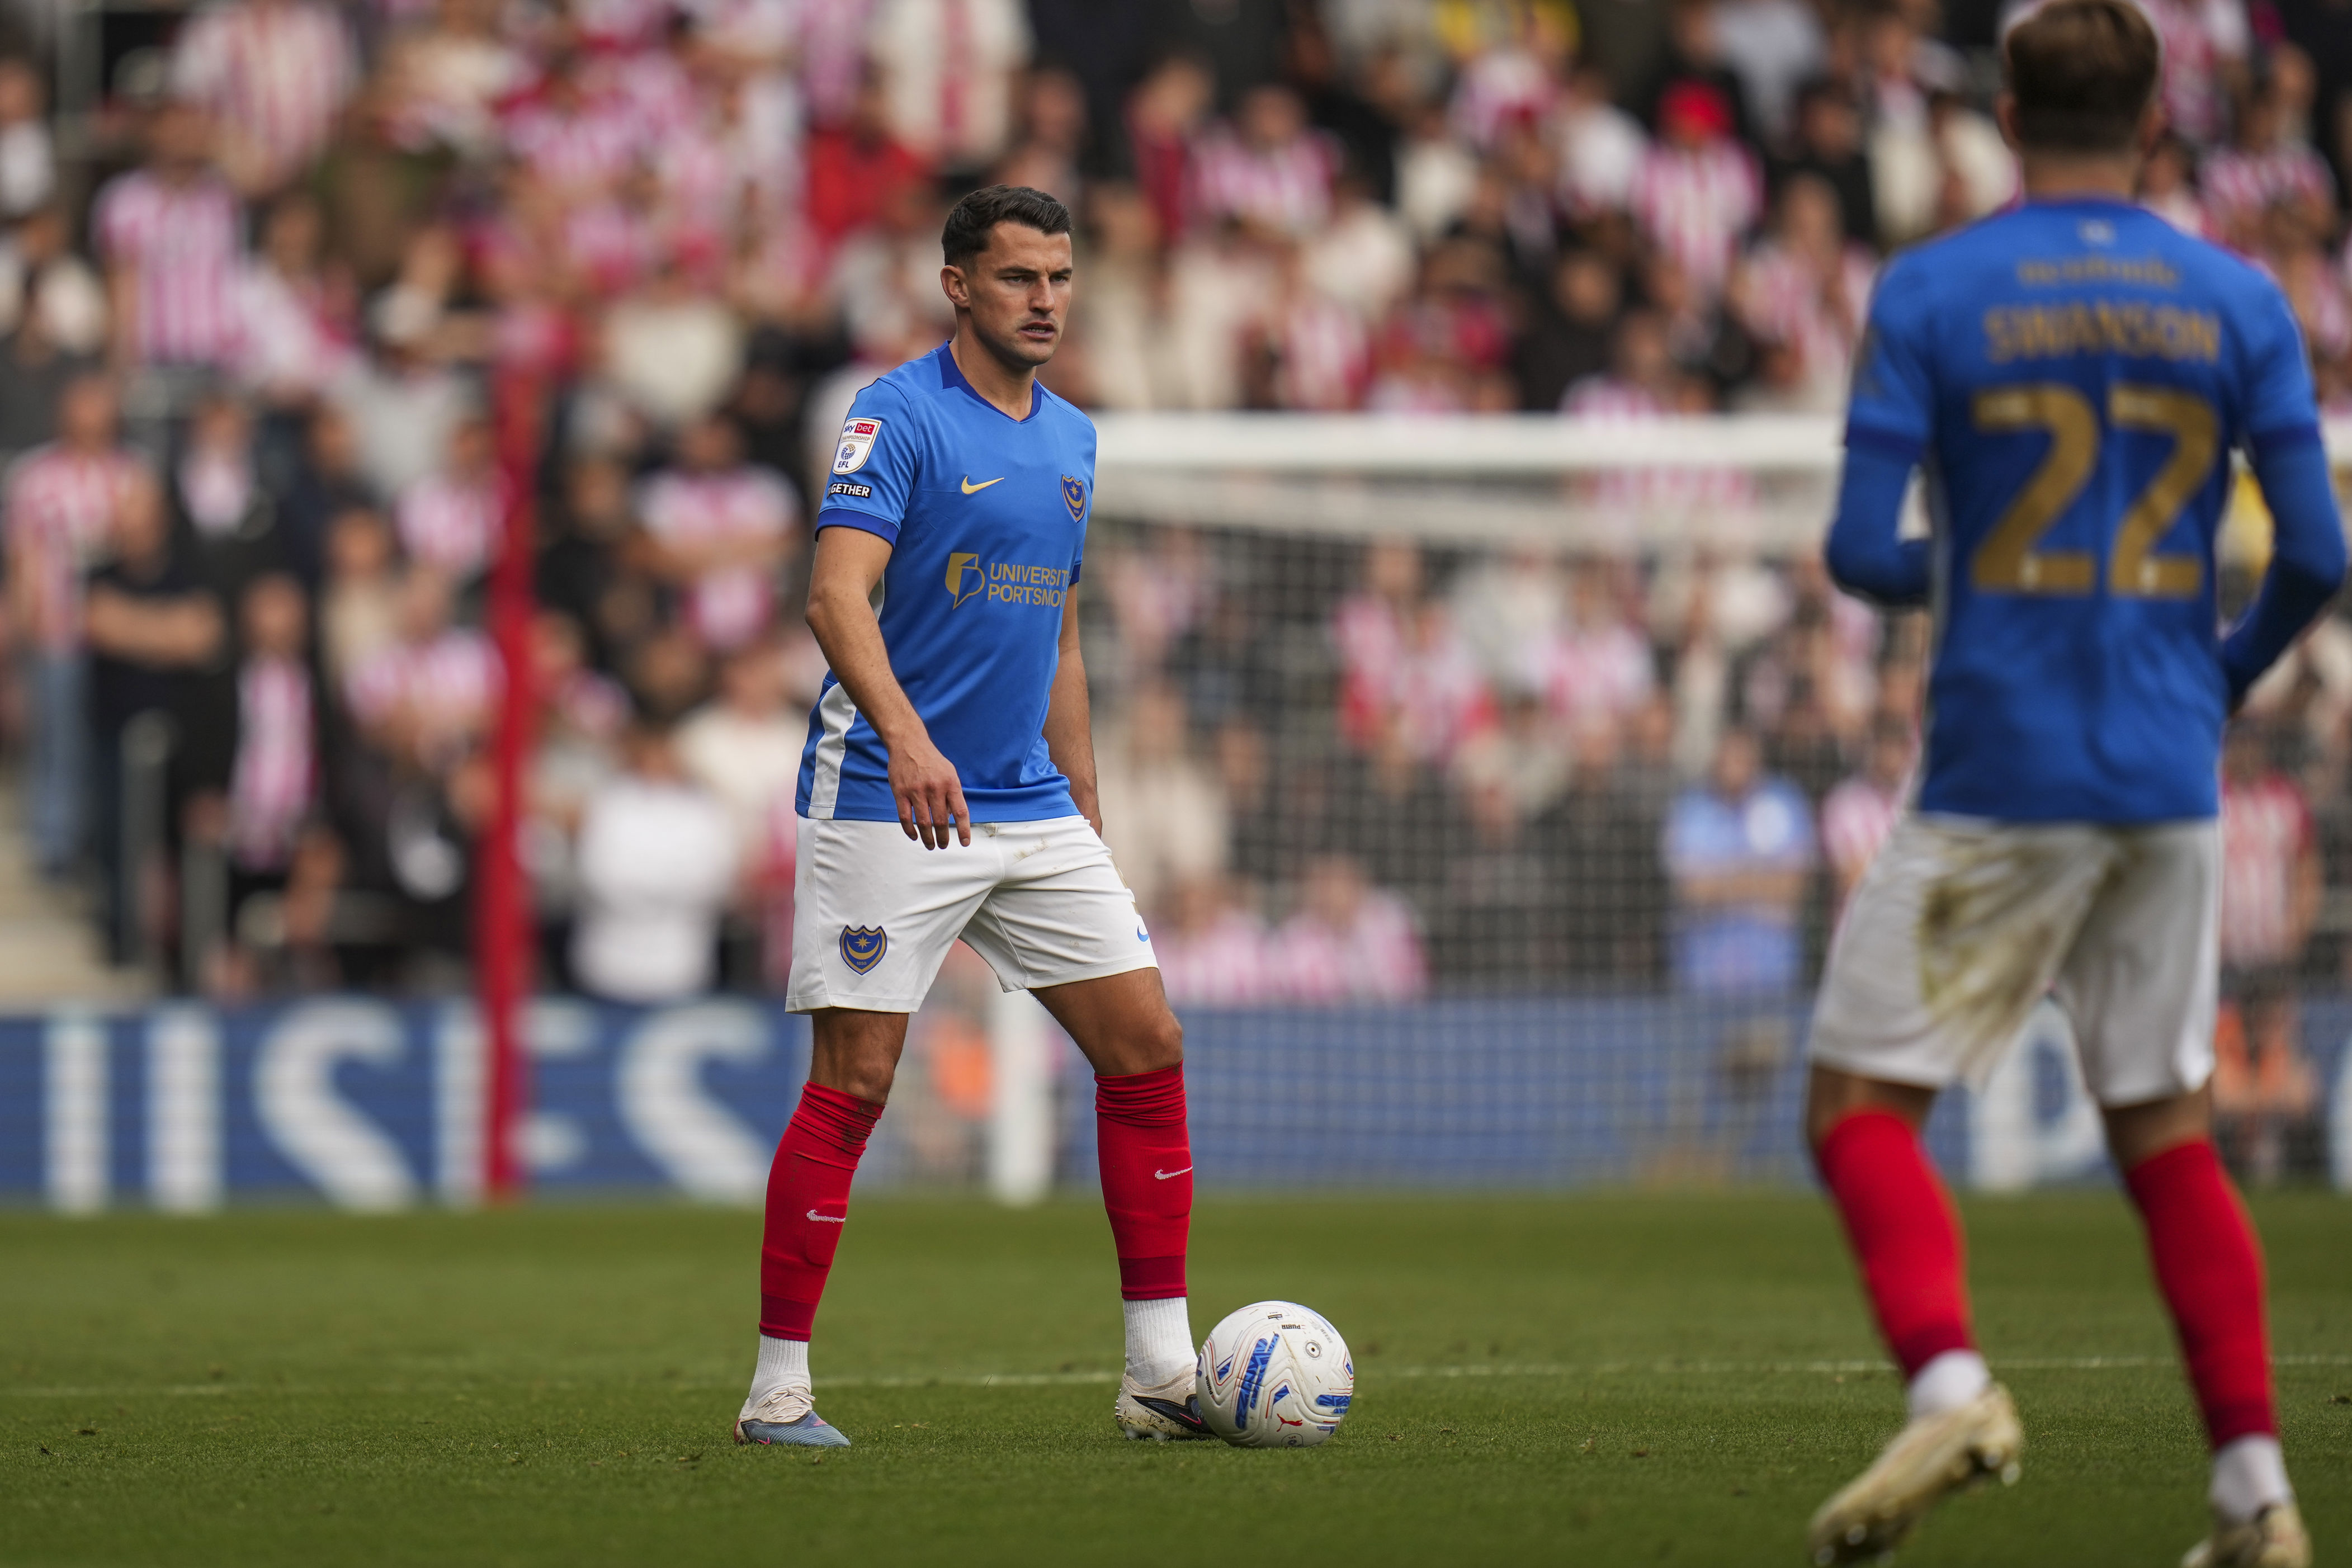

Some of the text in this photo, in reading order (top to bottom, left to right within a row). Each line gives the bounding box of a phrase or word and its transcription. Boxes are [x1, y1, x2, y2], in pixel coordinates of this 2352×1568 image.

[1985, 304, 2219, 362] SWANSON
[843, 424, 873, 433] sky bet
[1973, 385, 2217, 593] 22
[990, 563, 1070, 586] UNIVERSIT
[1145, 1410, 1164, 1423] PHANTO
